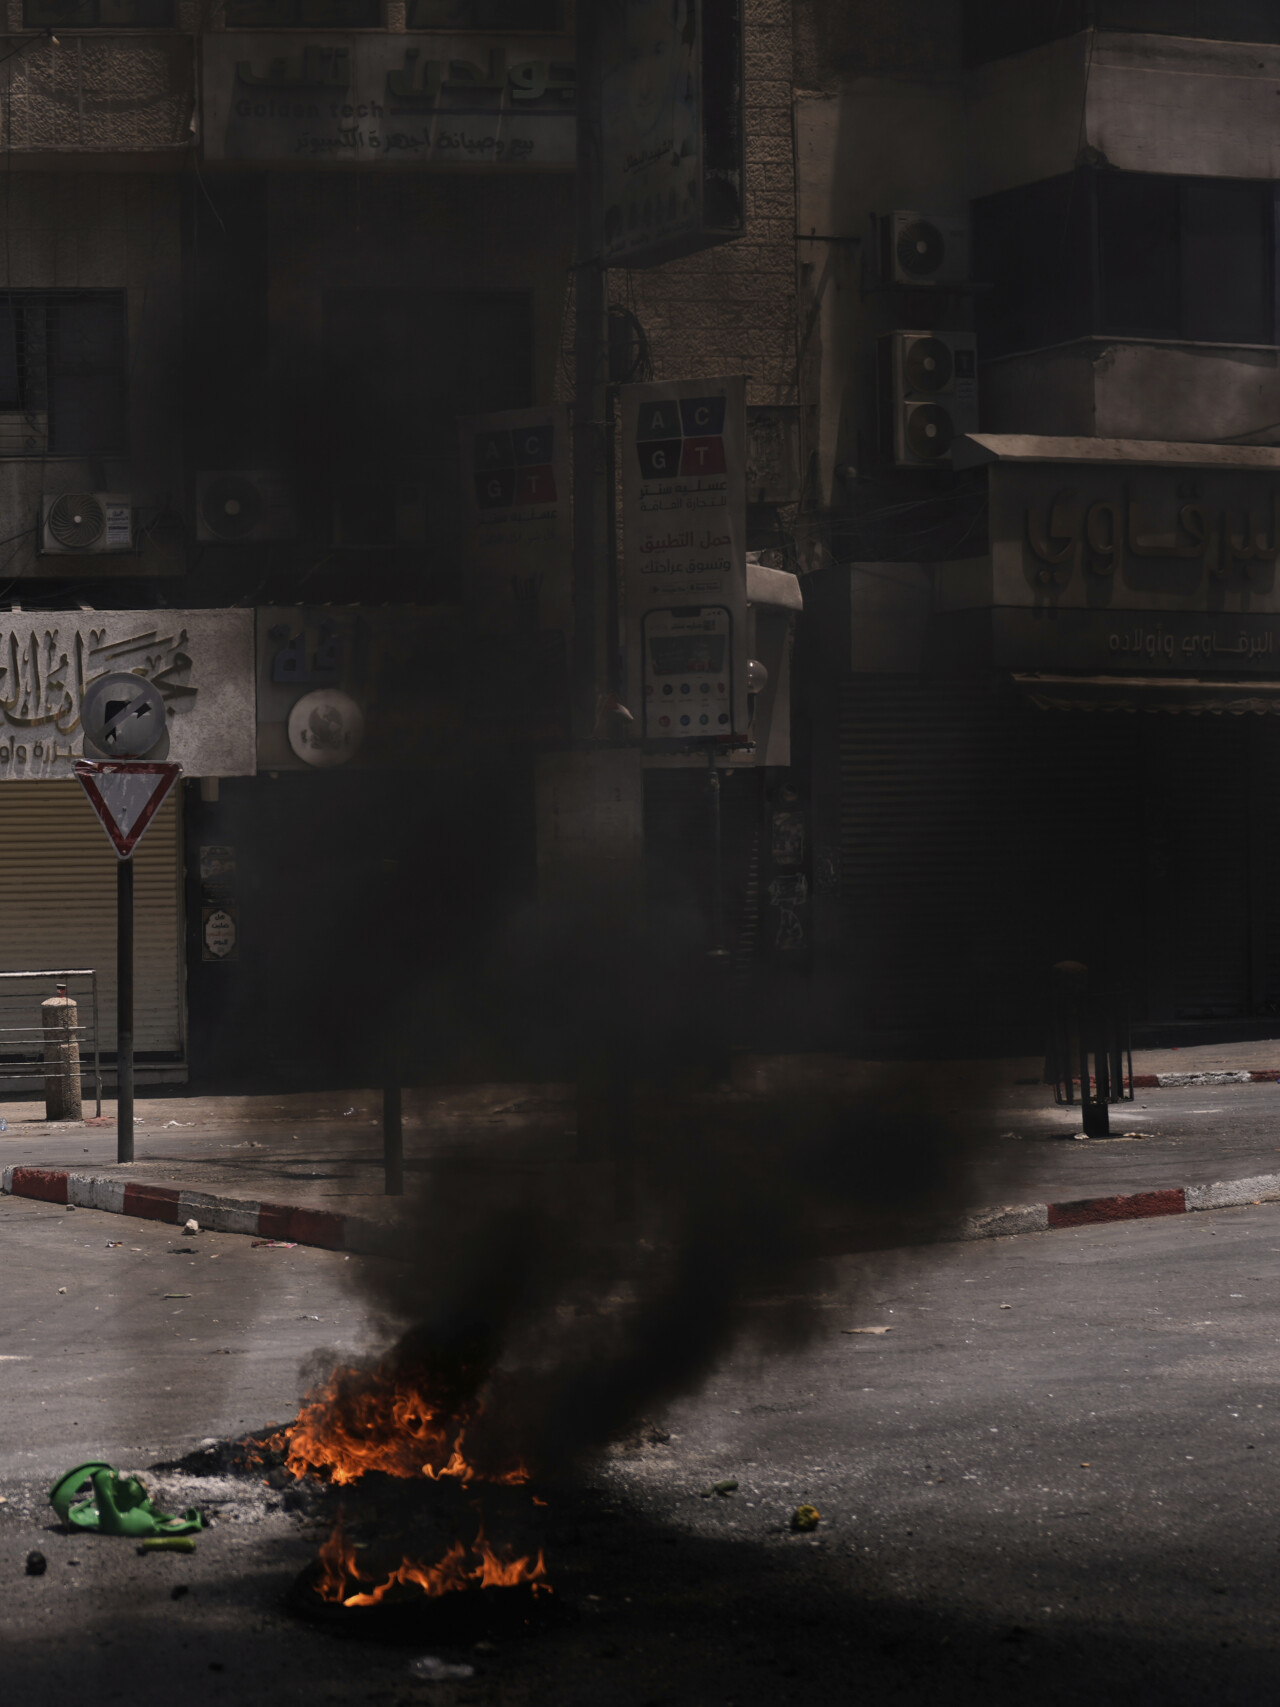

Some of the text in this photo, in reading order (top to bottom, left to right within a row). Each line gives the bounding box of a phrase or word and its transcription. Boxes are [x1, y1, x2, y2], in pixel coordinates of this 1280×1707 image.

[235, 99, 384, 120] Golden tech
[651, 406, 710, 430] A C
[651, 446, 710, 470] G T
[639, 529, 731, 554] حمل التطبيق
[685, 558, 732, 574] وتسوق
[1108, 621, 1273, 658] البرقاوي وأولاده
